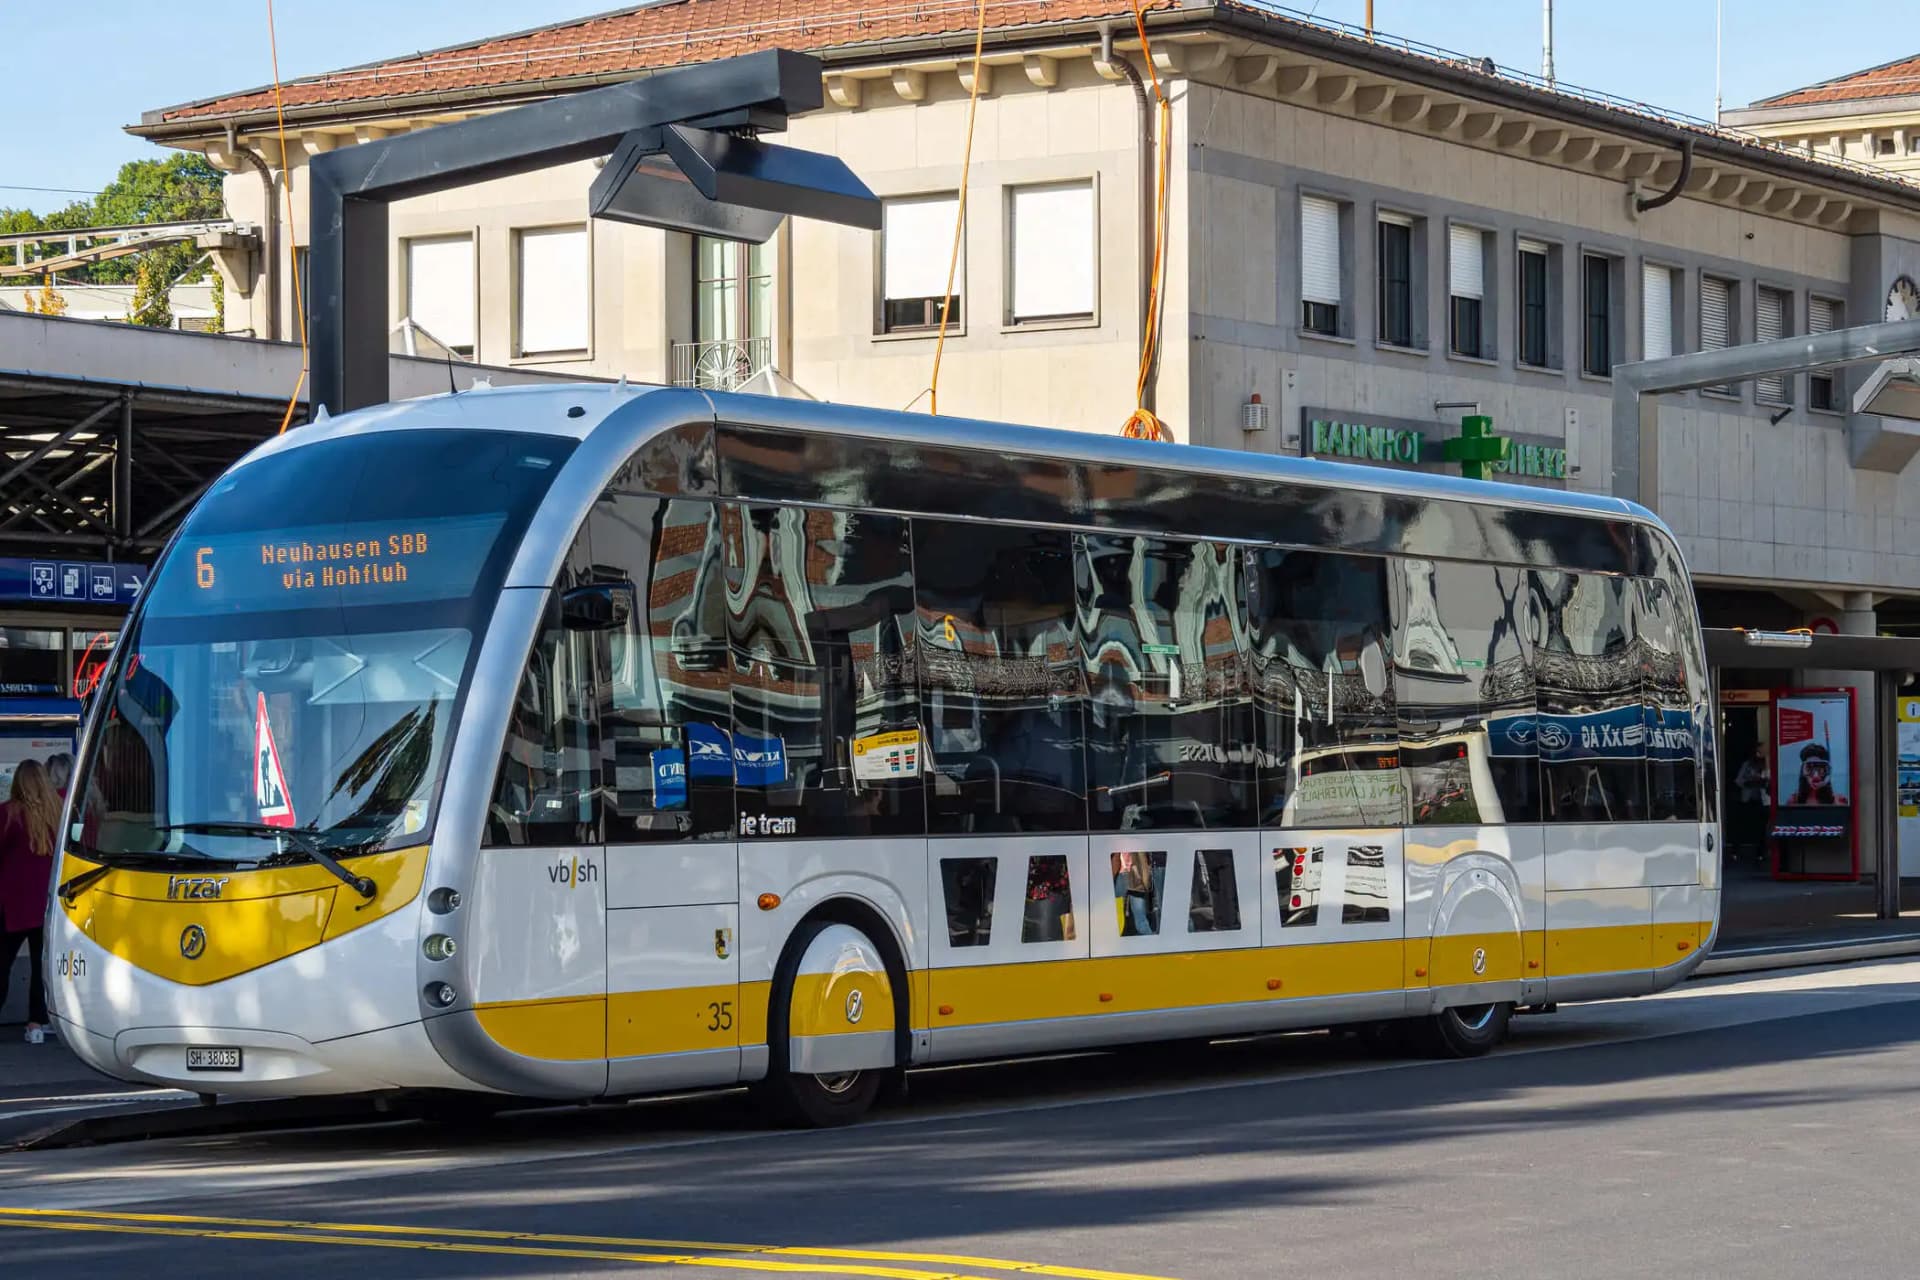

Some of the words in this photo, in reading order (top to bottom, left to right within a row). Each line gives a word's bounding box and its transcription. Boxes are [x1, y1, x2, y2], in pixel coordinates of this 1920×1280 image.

[261, 540, 381, 565] Neuhausen
[388, 532, 428, 555] SBB
[196, 547, 215, 588] 6
[282, 569, 315, 589] via
[322, 561, 408, 587] Hohfluh
[944, 614, 956, 642] 6
[739, 811, 756, 835] ie
[760, 813, 797, 834] tram
[707, 1001, 733, 1032] 35
